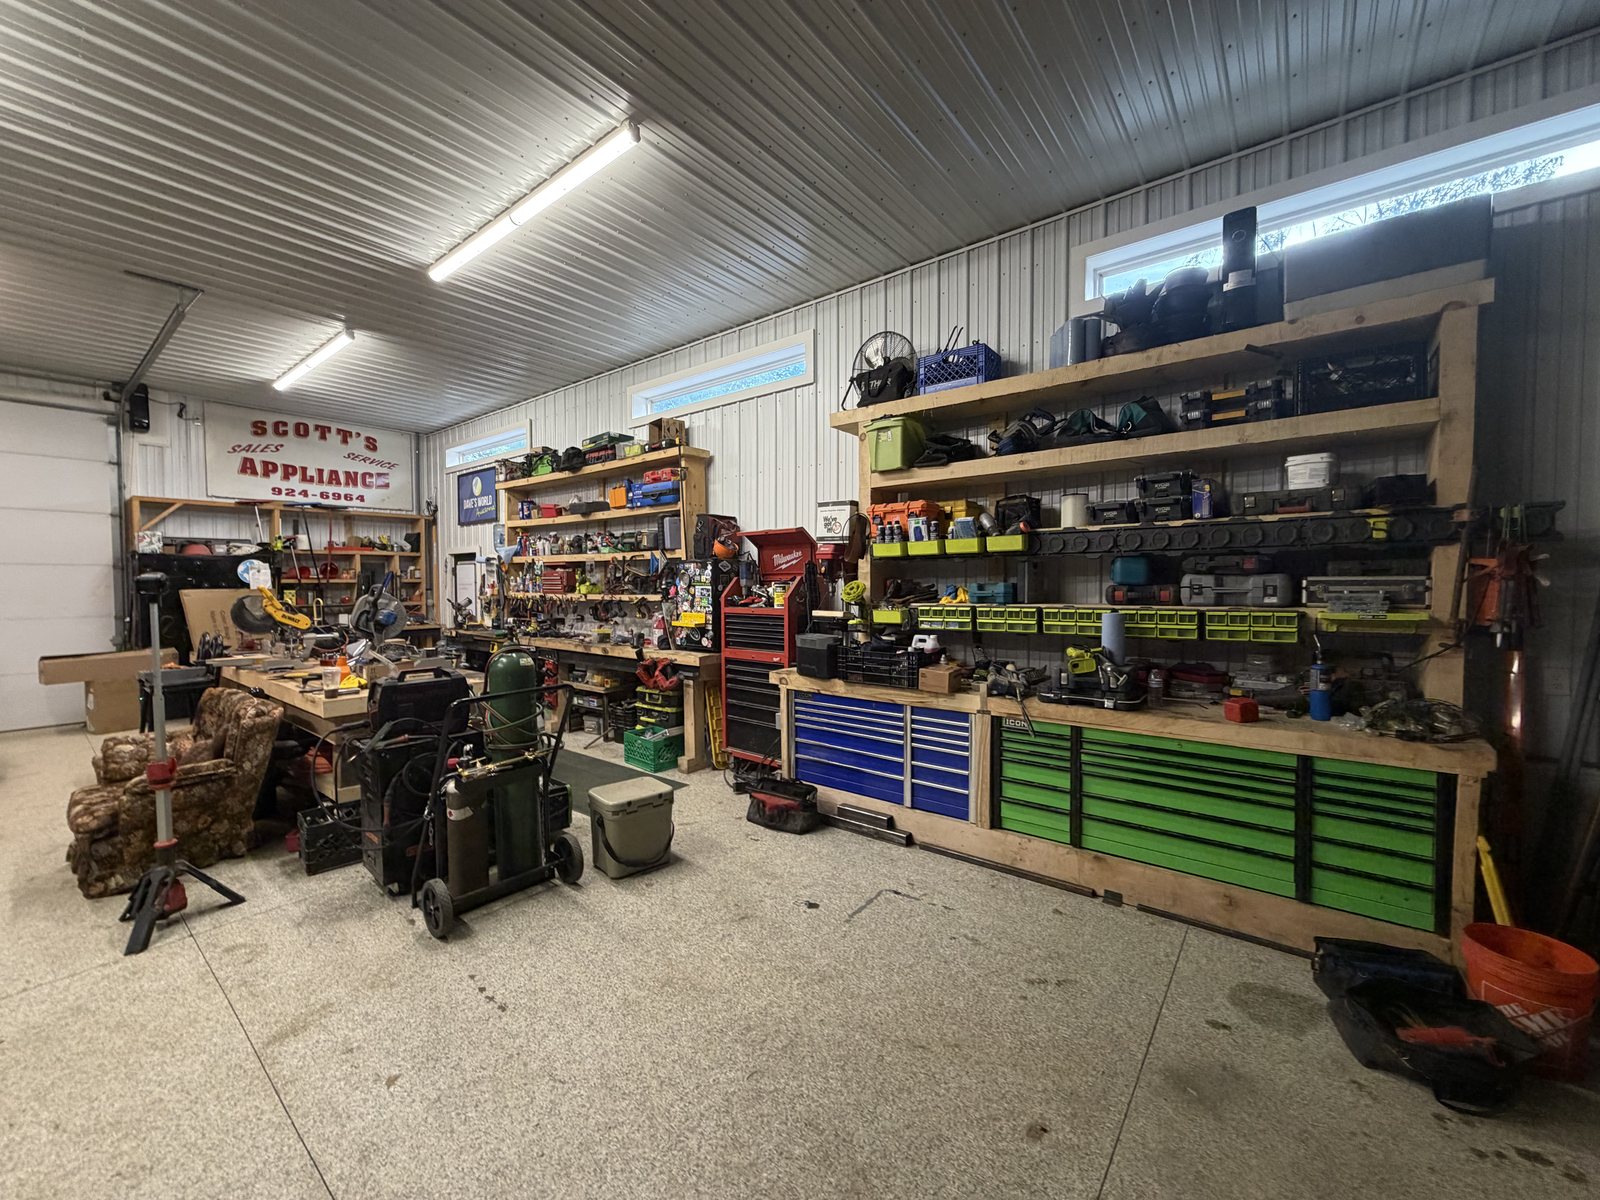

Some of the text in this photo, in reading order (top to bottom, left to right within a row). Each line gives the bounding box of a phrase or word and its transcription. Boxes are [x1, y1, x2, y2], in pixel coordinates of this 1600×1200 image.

[251, 420, 379, 453] SCOTT'S
[227, 444, 285, 454] SALES
[343, 452, 400, 470] SERVICE
[238, 457, 391, 490] APPLIANCE
[271, 486, 366, 503] 924-6964
[478, 494, 493, 507] WORLD
[772, 550, 803, 567] Milwaukee
